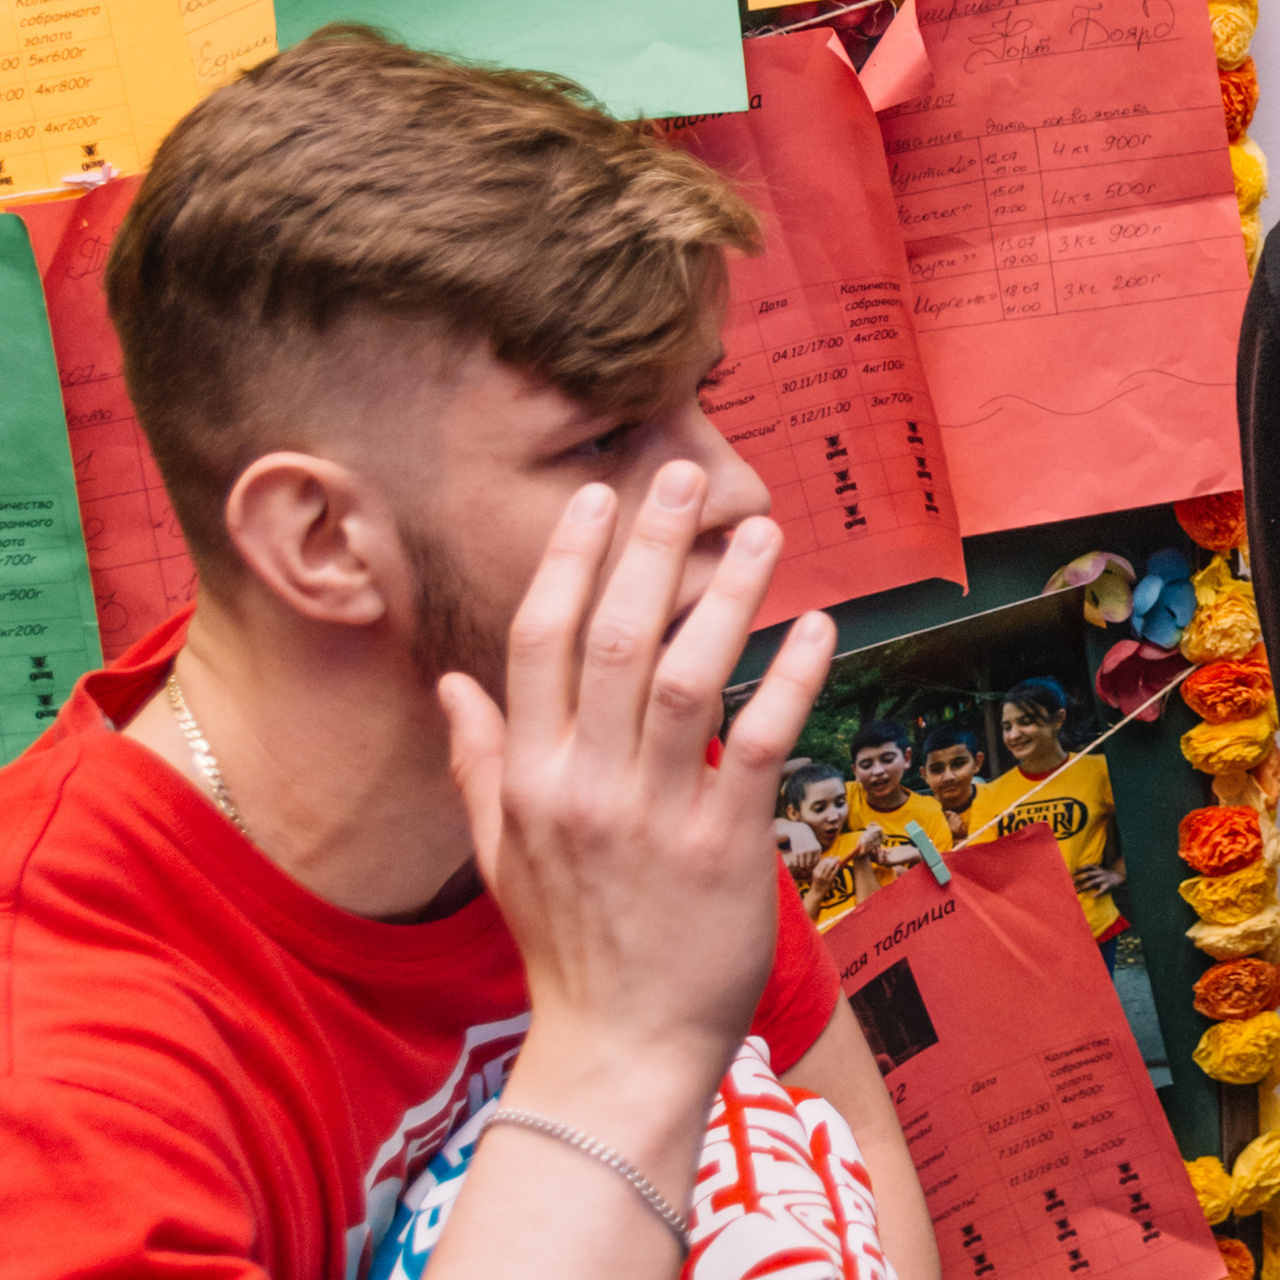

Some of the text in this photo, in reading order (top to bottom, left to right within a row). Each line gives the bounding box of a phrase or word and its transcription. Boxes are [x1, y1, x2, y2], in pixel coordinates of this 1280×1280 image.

[20, 5, 101, 28] собранного
[25, 31, 73, 47] золота
[29, 46, 87, 67] 5кг600г
[35, 77, 94, 95] 4кг800г
[44, 114, 102, 133] 4кг200г
[758, 298, 788, 315] Дата
[849, 314, 889, 328] золота
[873, 899, 956, 957] таблица
